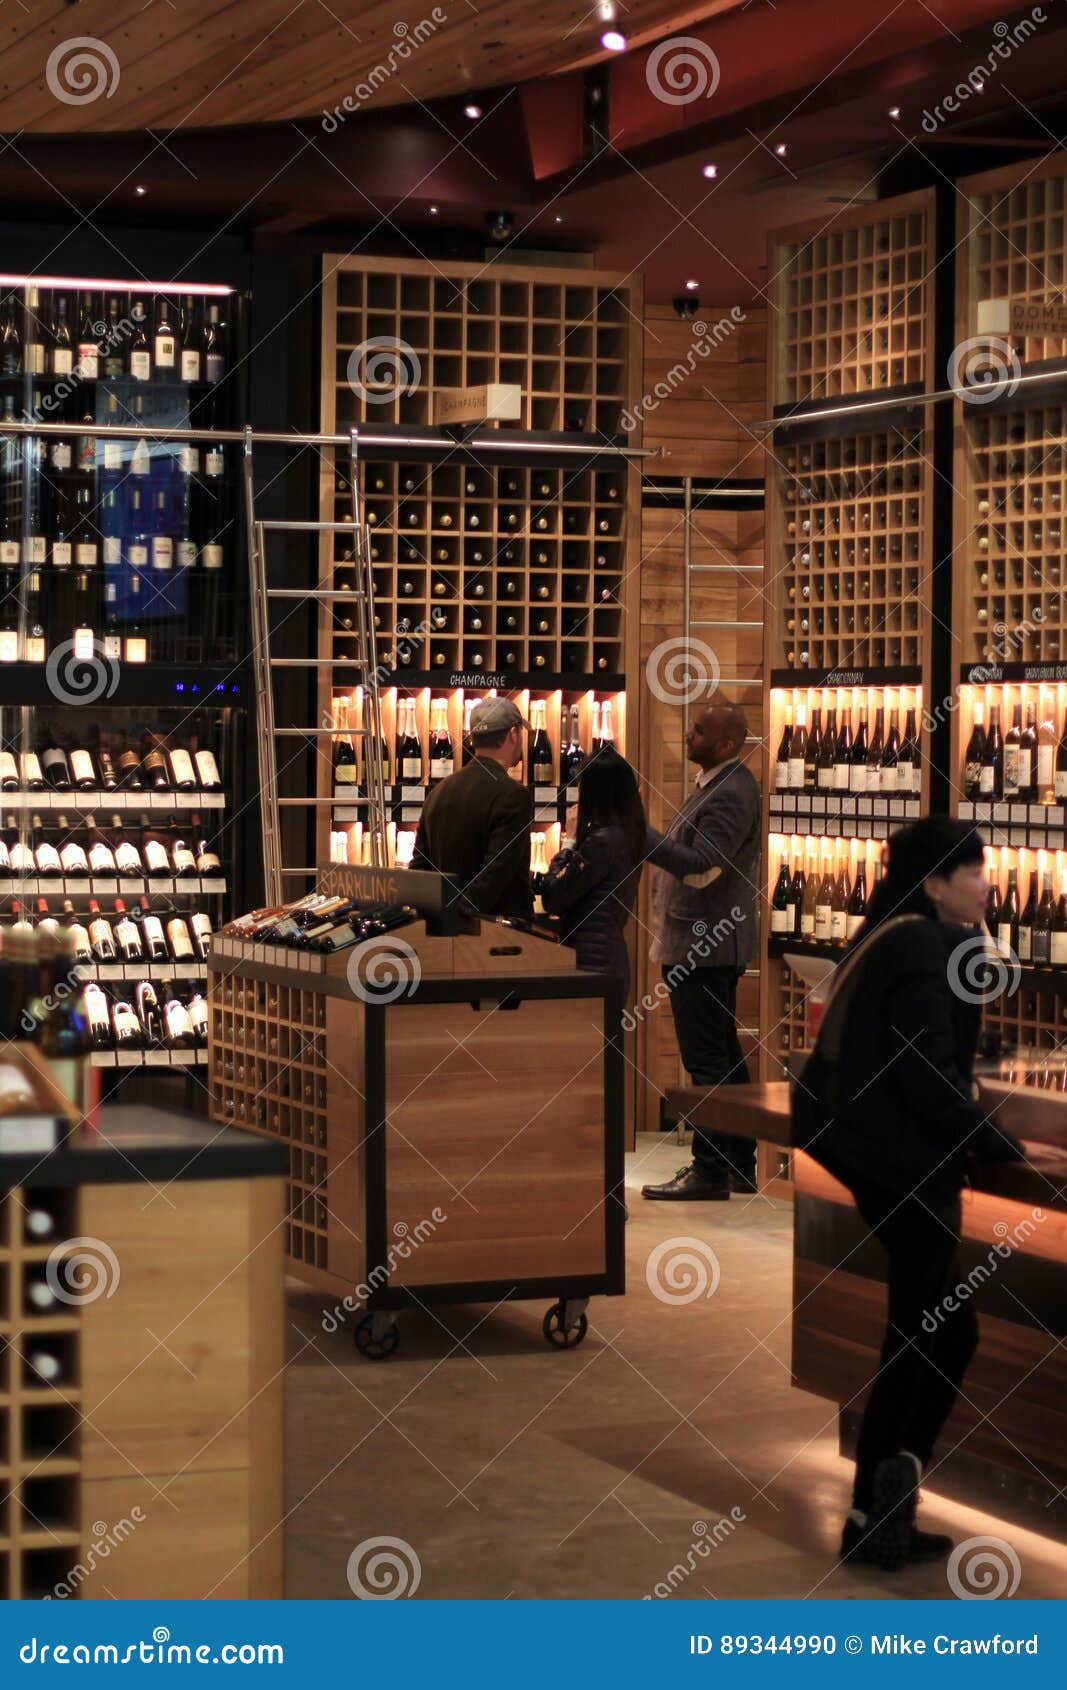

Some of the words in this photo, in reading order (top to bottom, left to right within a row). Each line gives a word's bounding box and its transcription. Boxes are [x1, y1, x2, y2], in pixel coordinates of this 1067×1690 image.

[1013, 304, 1067, 319] DOME
[449, 673, 507, 687] CHAMPAGNE
[319, 869, 399, 905] SPARKLING
